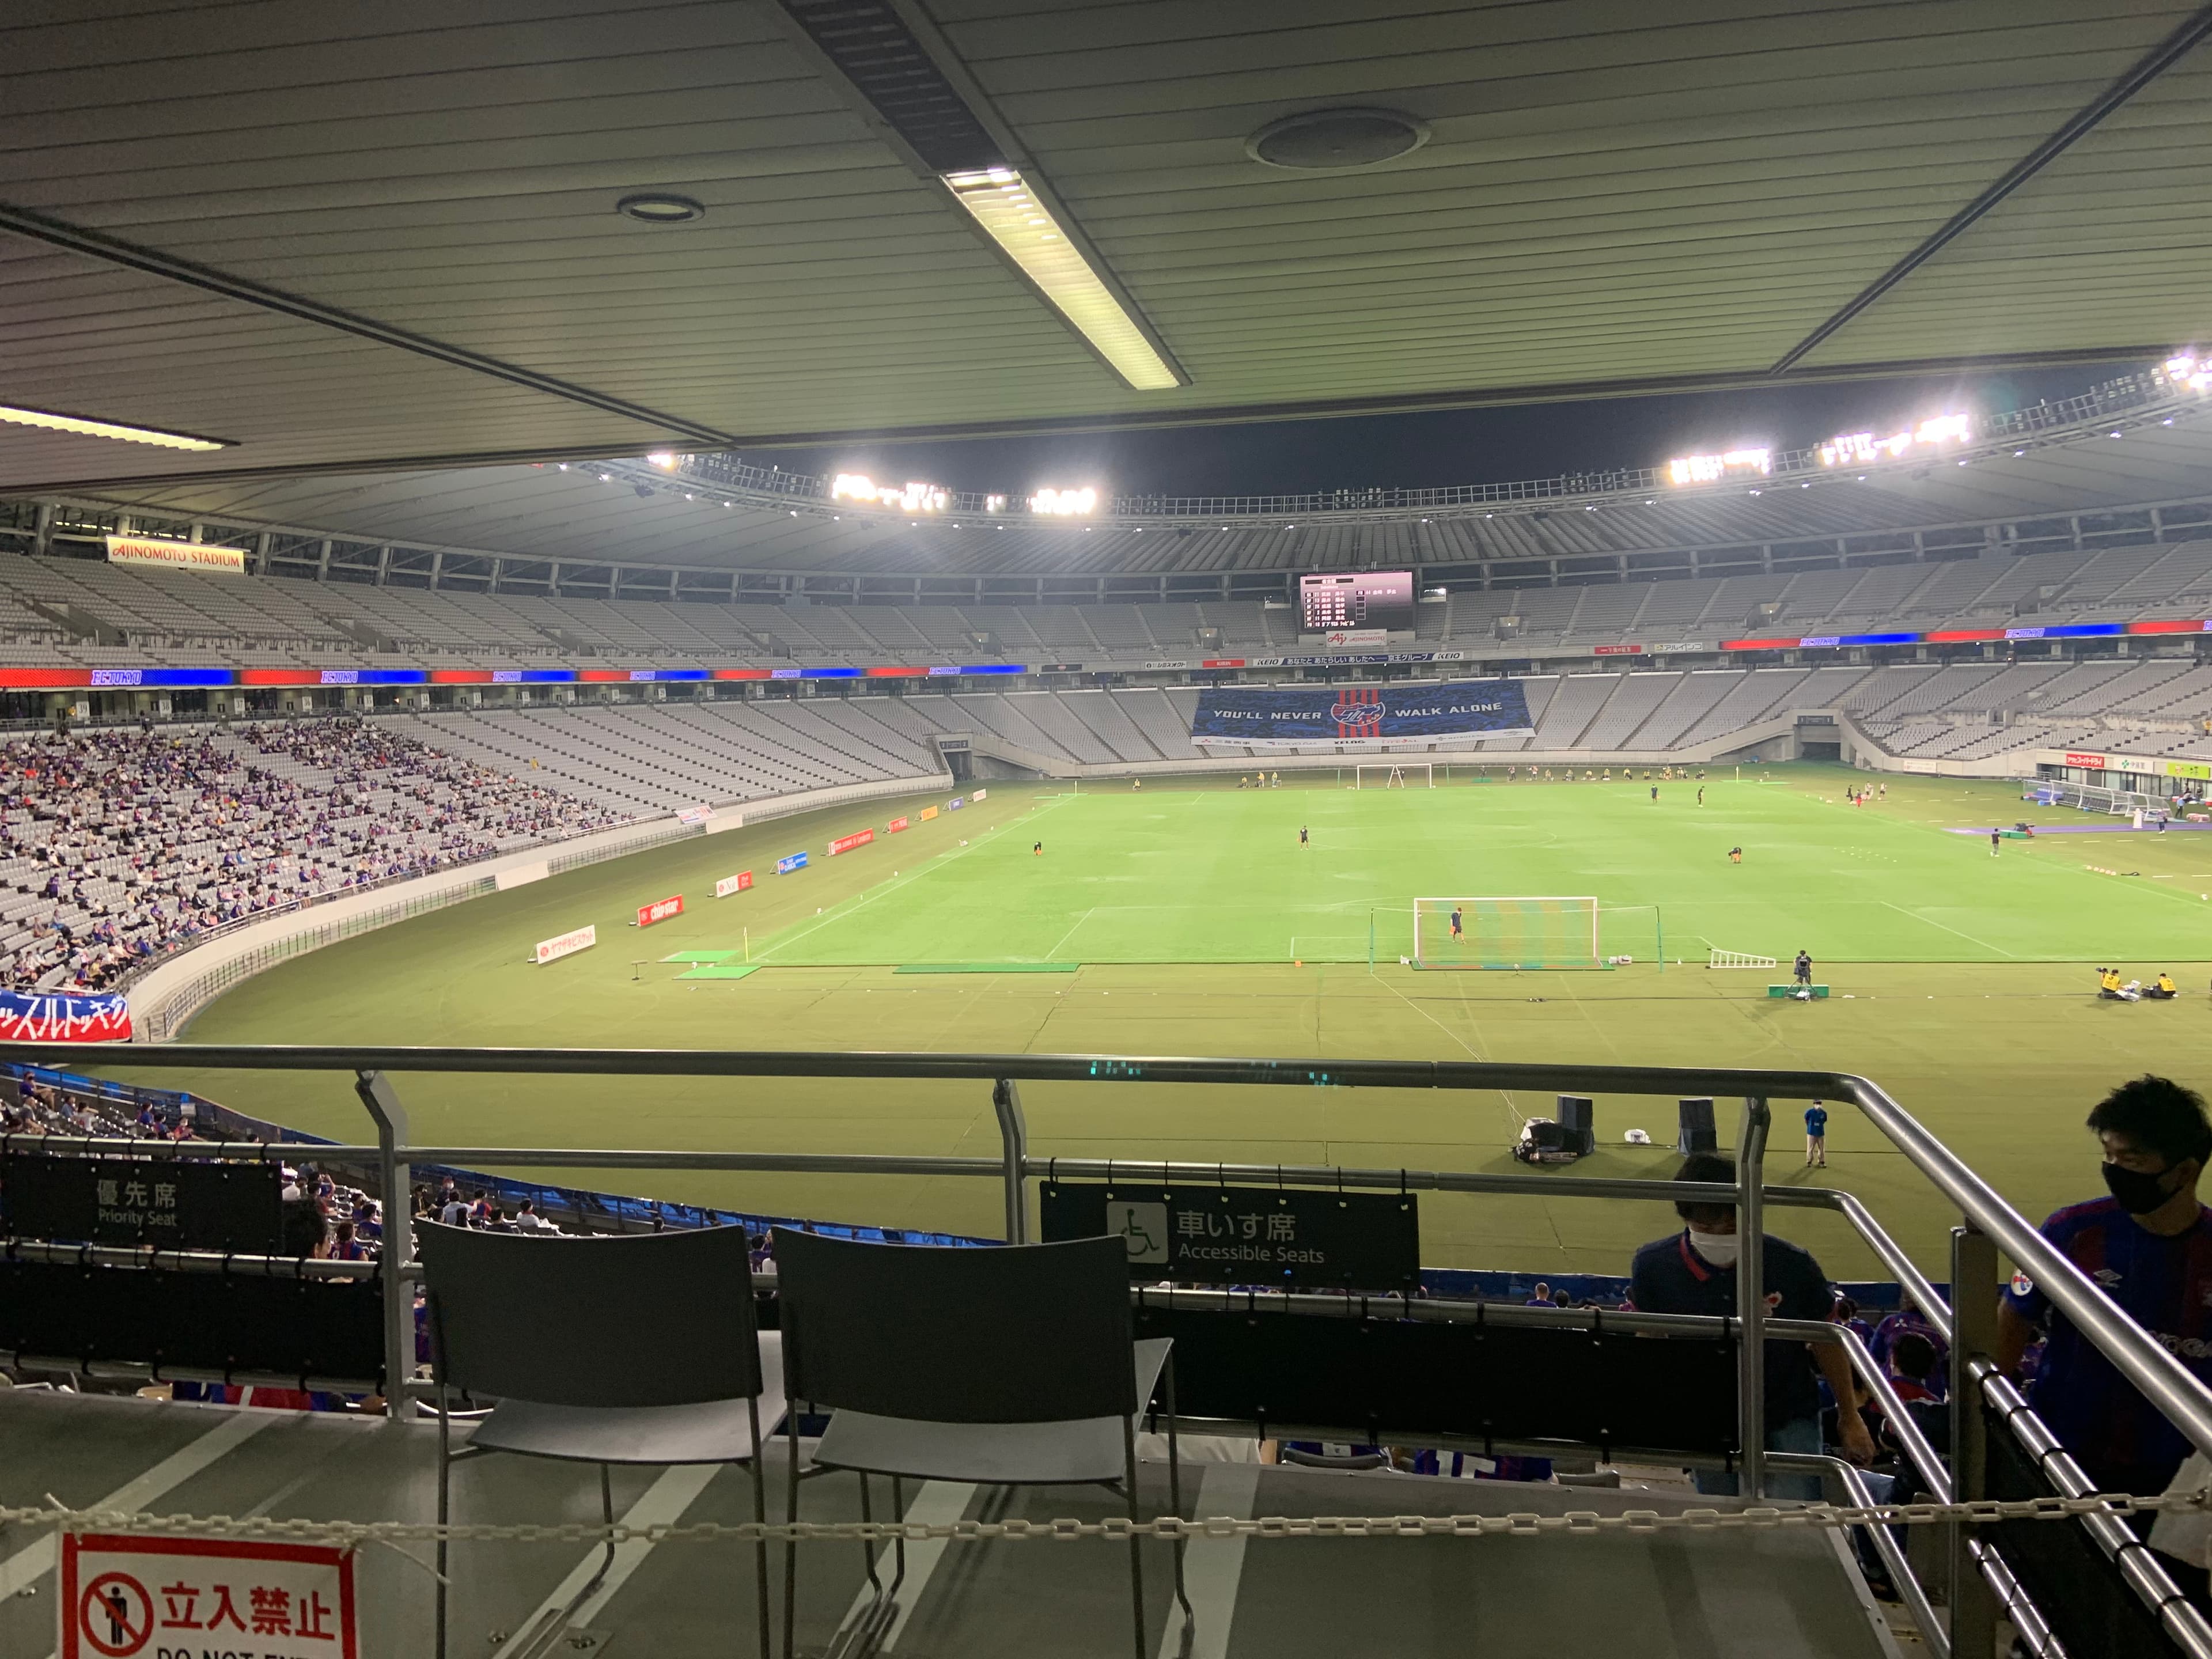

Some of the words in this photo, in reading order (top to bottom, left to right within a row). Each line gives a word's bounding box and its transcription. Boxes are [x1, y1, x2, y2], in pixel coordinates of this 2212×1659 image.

[112, 544, 186, 562] AJINOMOTO
[192, 551, 240, 567] STADIUM
[79, 704, 87, 714] 39
[162, 701, 170, 710] 38
[1214, 710, 1263, 719] YOU'LL
[1395, 707, 1442, 717] WALK
[1449, 702, 1503, 714] ALONE
[97, 1180, 176, 1208] 優先席
[99, 1208, 143, 1227] Priority
[147, 1211, 177, 1226] Seat
[1176, 1210, 1296, 1242] 車いす席
[1179, 1243, 1271, 1262] Accessible
[1277, 1247, 1324, 1263] Seats
[161, 1581, 335, 1641] 立入禁止
